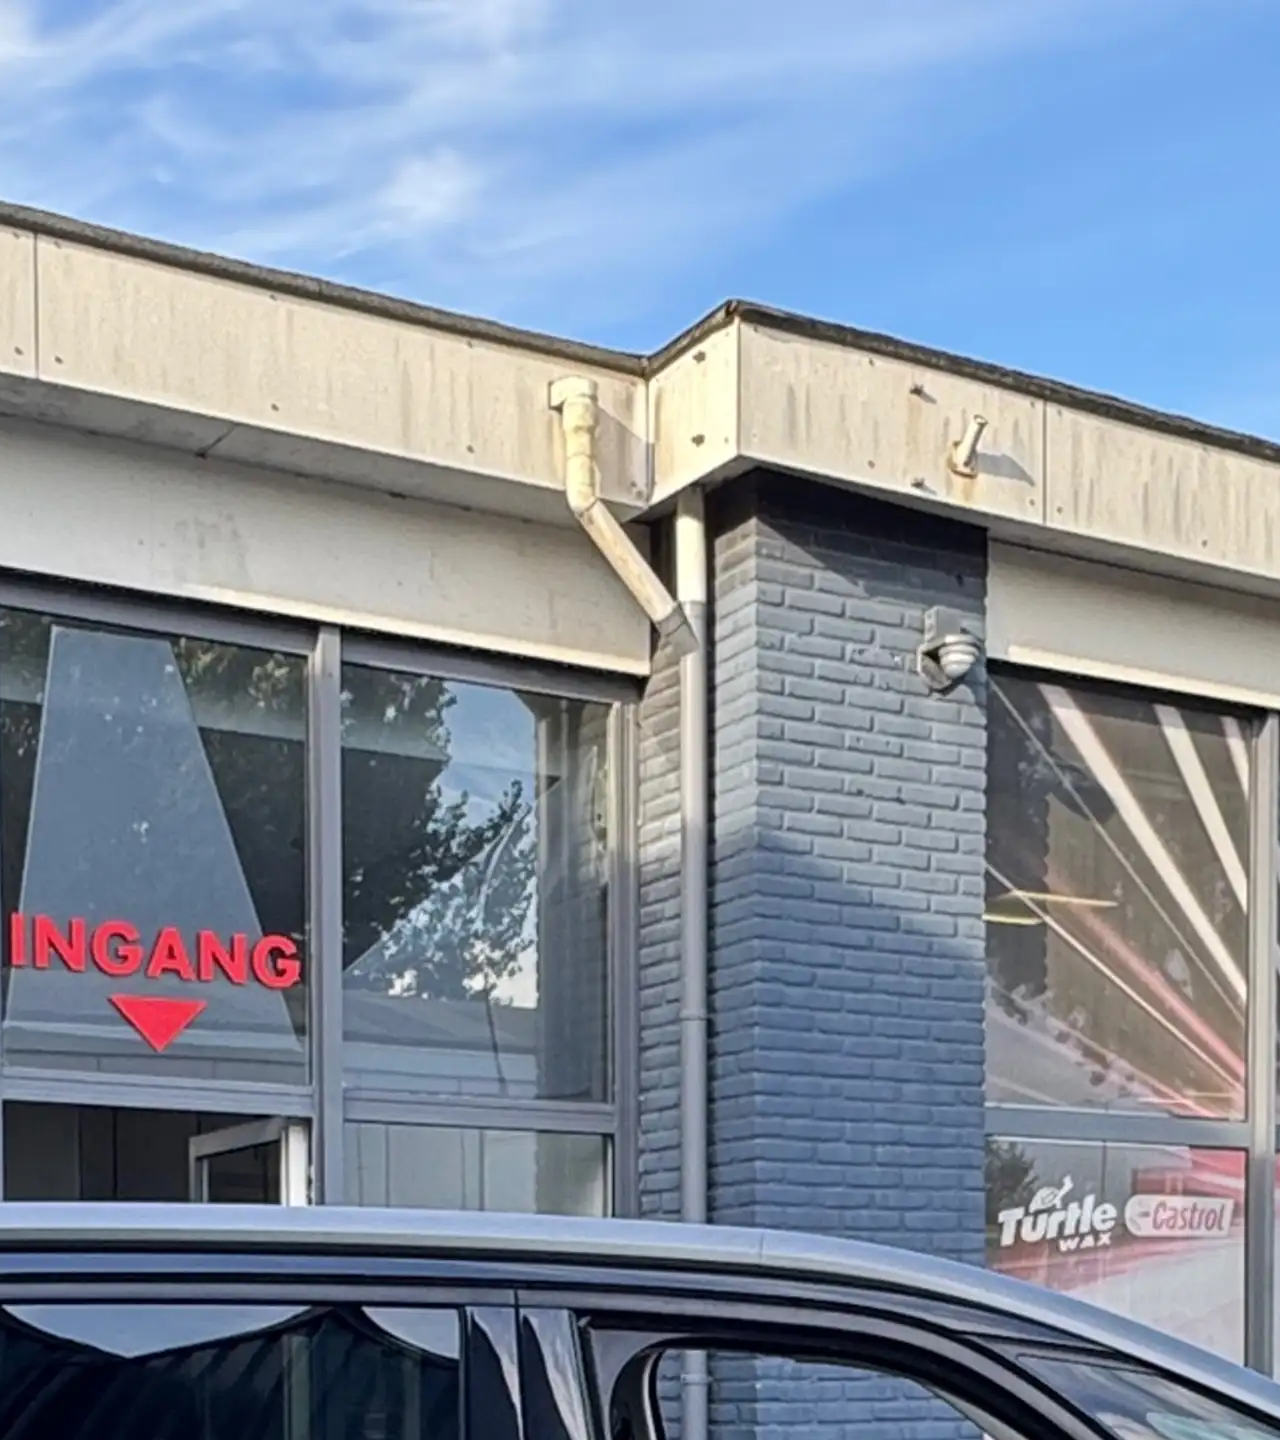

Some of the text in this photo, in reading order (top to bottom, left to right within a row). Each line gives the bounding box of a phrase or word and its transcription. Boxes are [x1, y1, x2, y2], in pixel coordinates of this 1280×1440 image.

[10, 911, 301, 989] INGANG
[998, 1194, 1118, 1247] Turtle
[1152, 1201, 1226, 1231] Castrol
[1058, 1231, 1112, 1252] WAX
